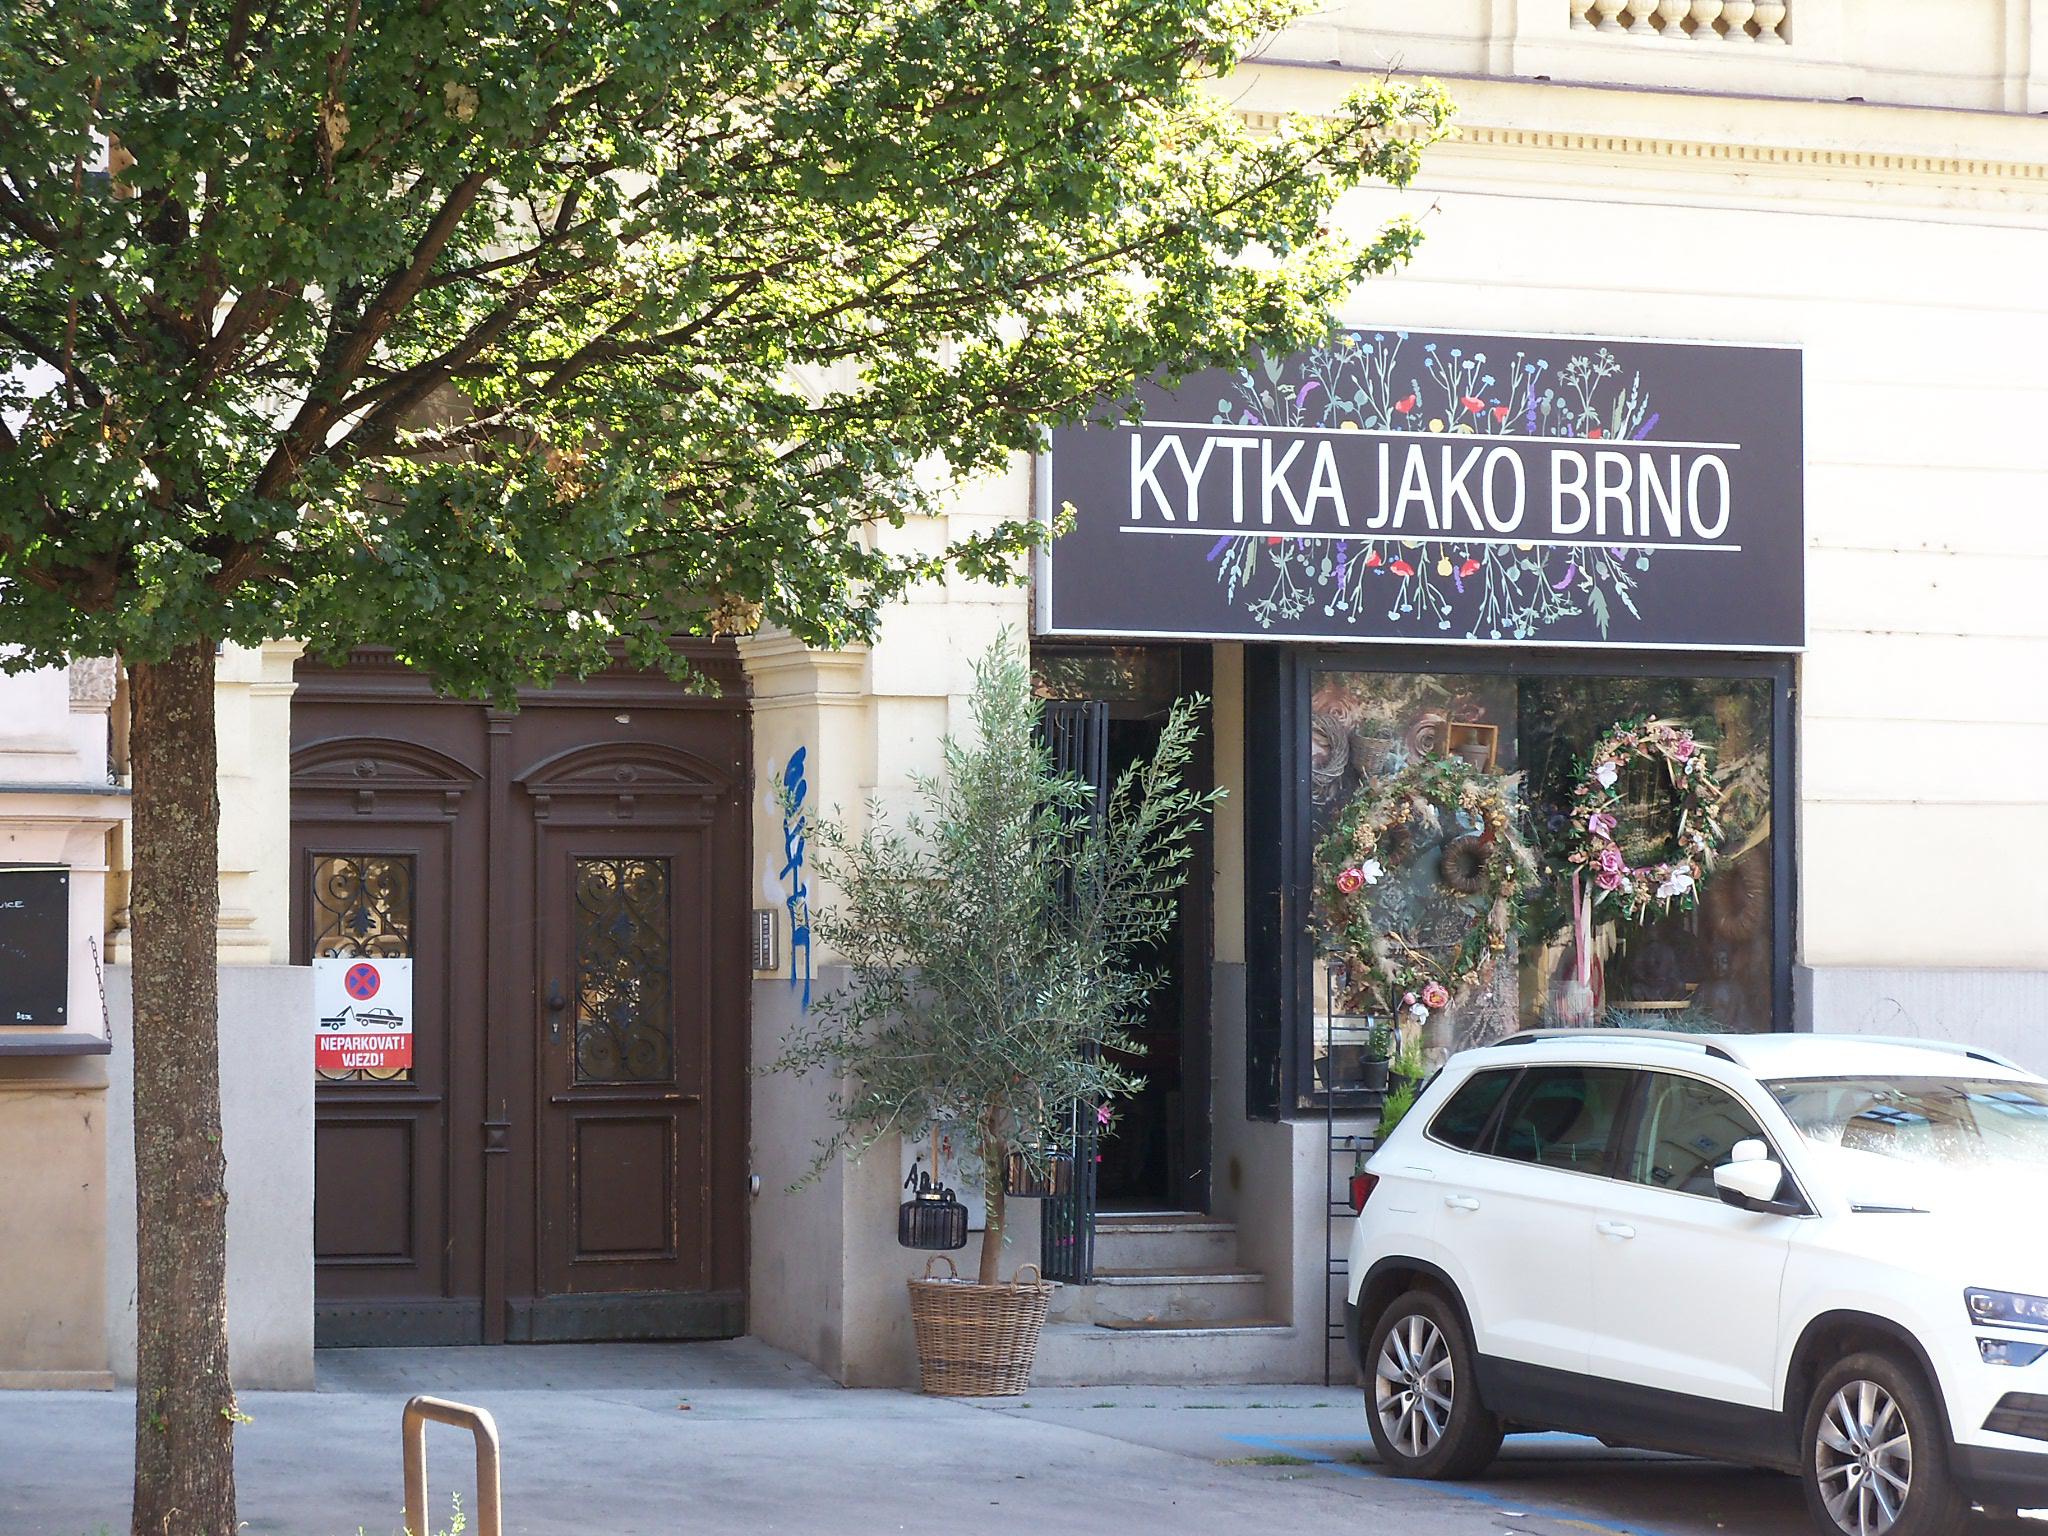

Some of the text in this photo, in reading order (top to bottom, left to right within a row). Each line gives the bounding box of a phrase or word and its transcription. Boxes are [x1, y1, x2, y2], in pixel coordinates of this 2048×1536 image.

[1131, 434, 1730, 539] KYTKA JAKO BRNO
[320, 1037, 405, 1051] NEPARKOVAT!
[342, 1053, 384, 1067] VJEZD!
